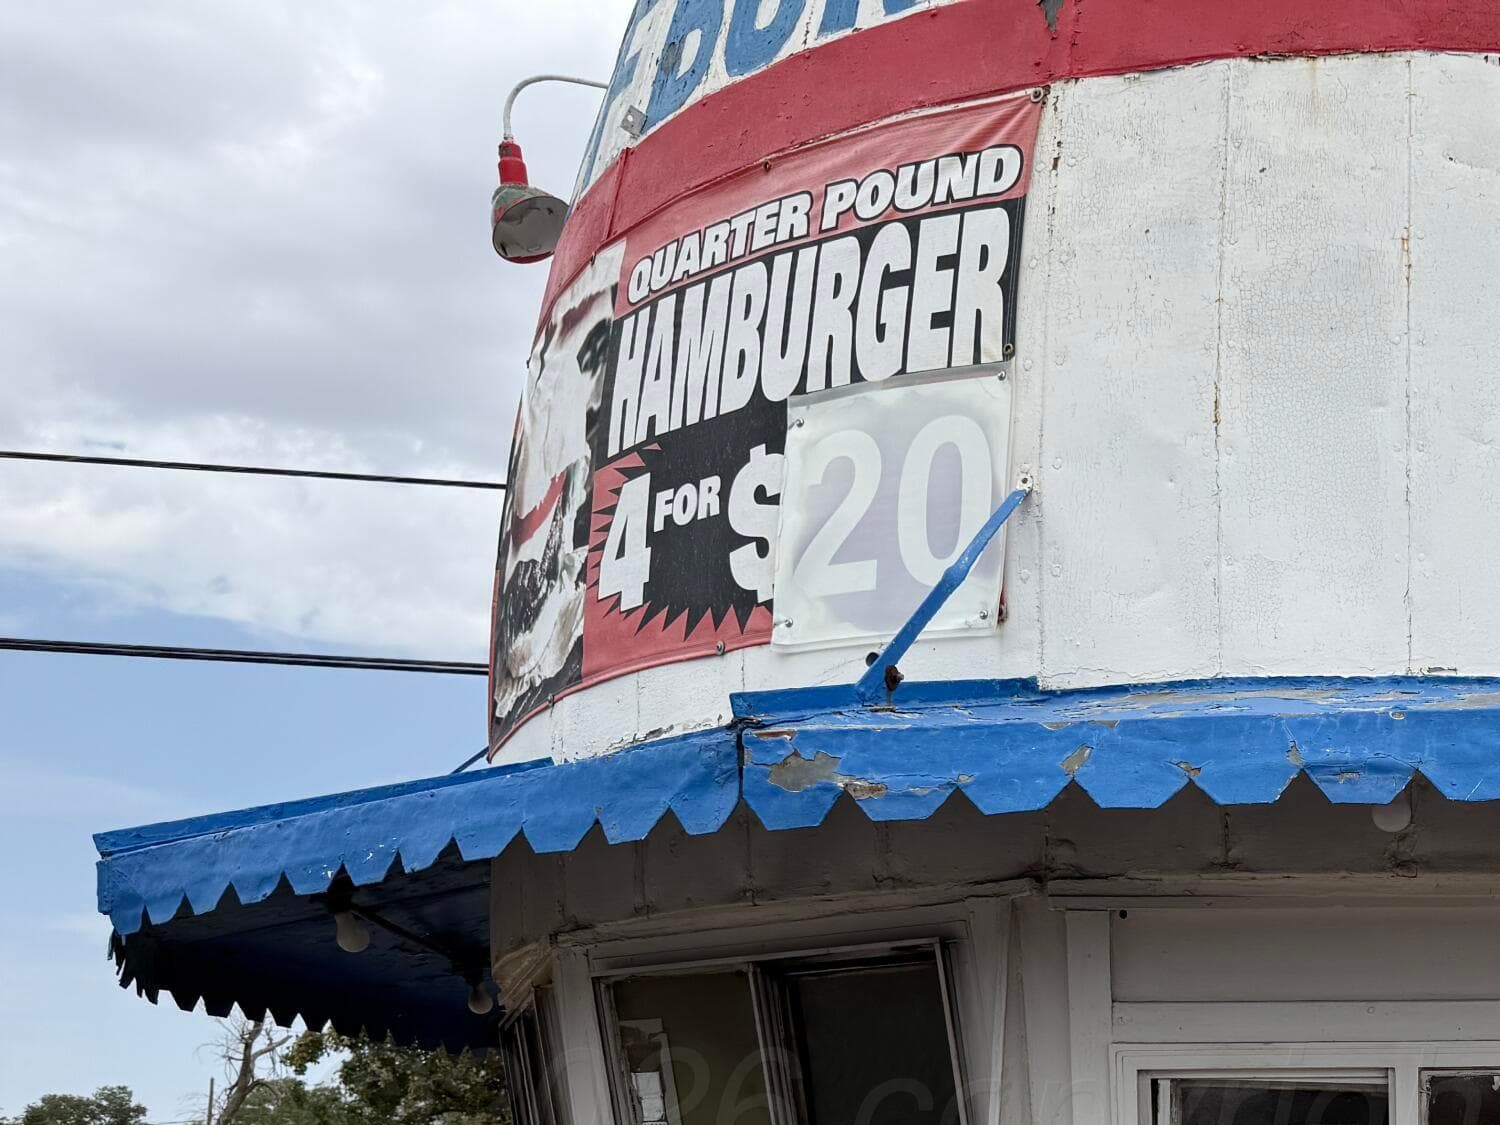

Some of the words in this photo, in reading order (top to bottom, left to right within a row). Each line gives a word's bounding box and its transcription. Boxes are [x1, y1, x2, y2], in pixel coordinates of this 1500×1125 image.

[628, 191, 814, 305] QUARTER
[821, 143, 1024, 232] POUND
[607, 206, 1013, 458] HAMBURGER
[598, 473, 652, 612] 4
[653, 474, 721, 532] FOR
